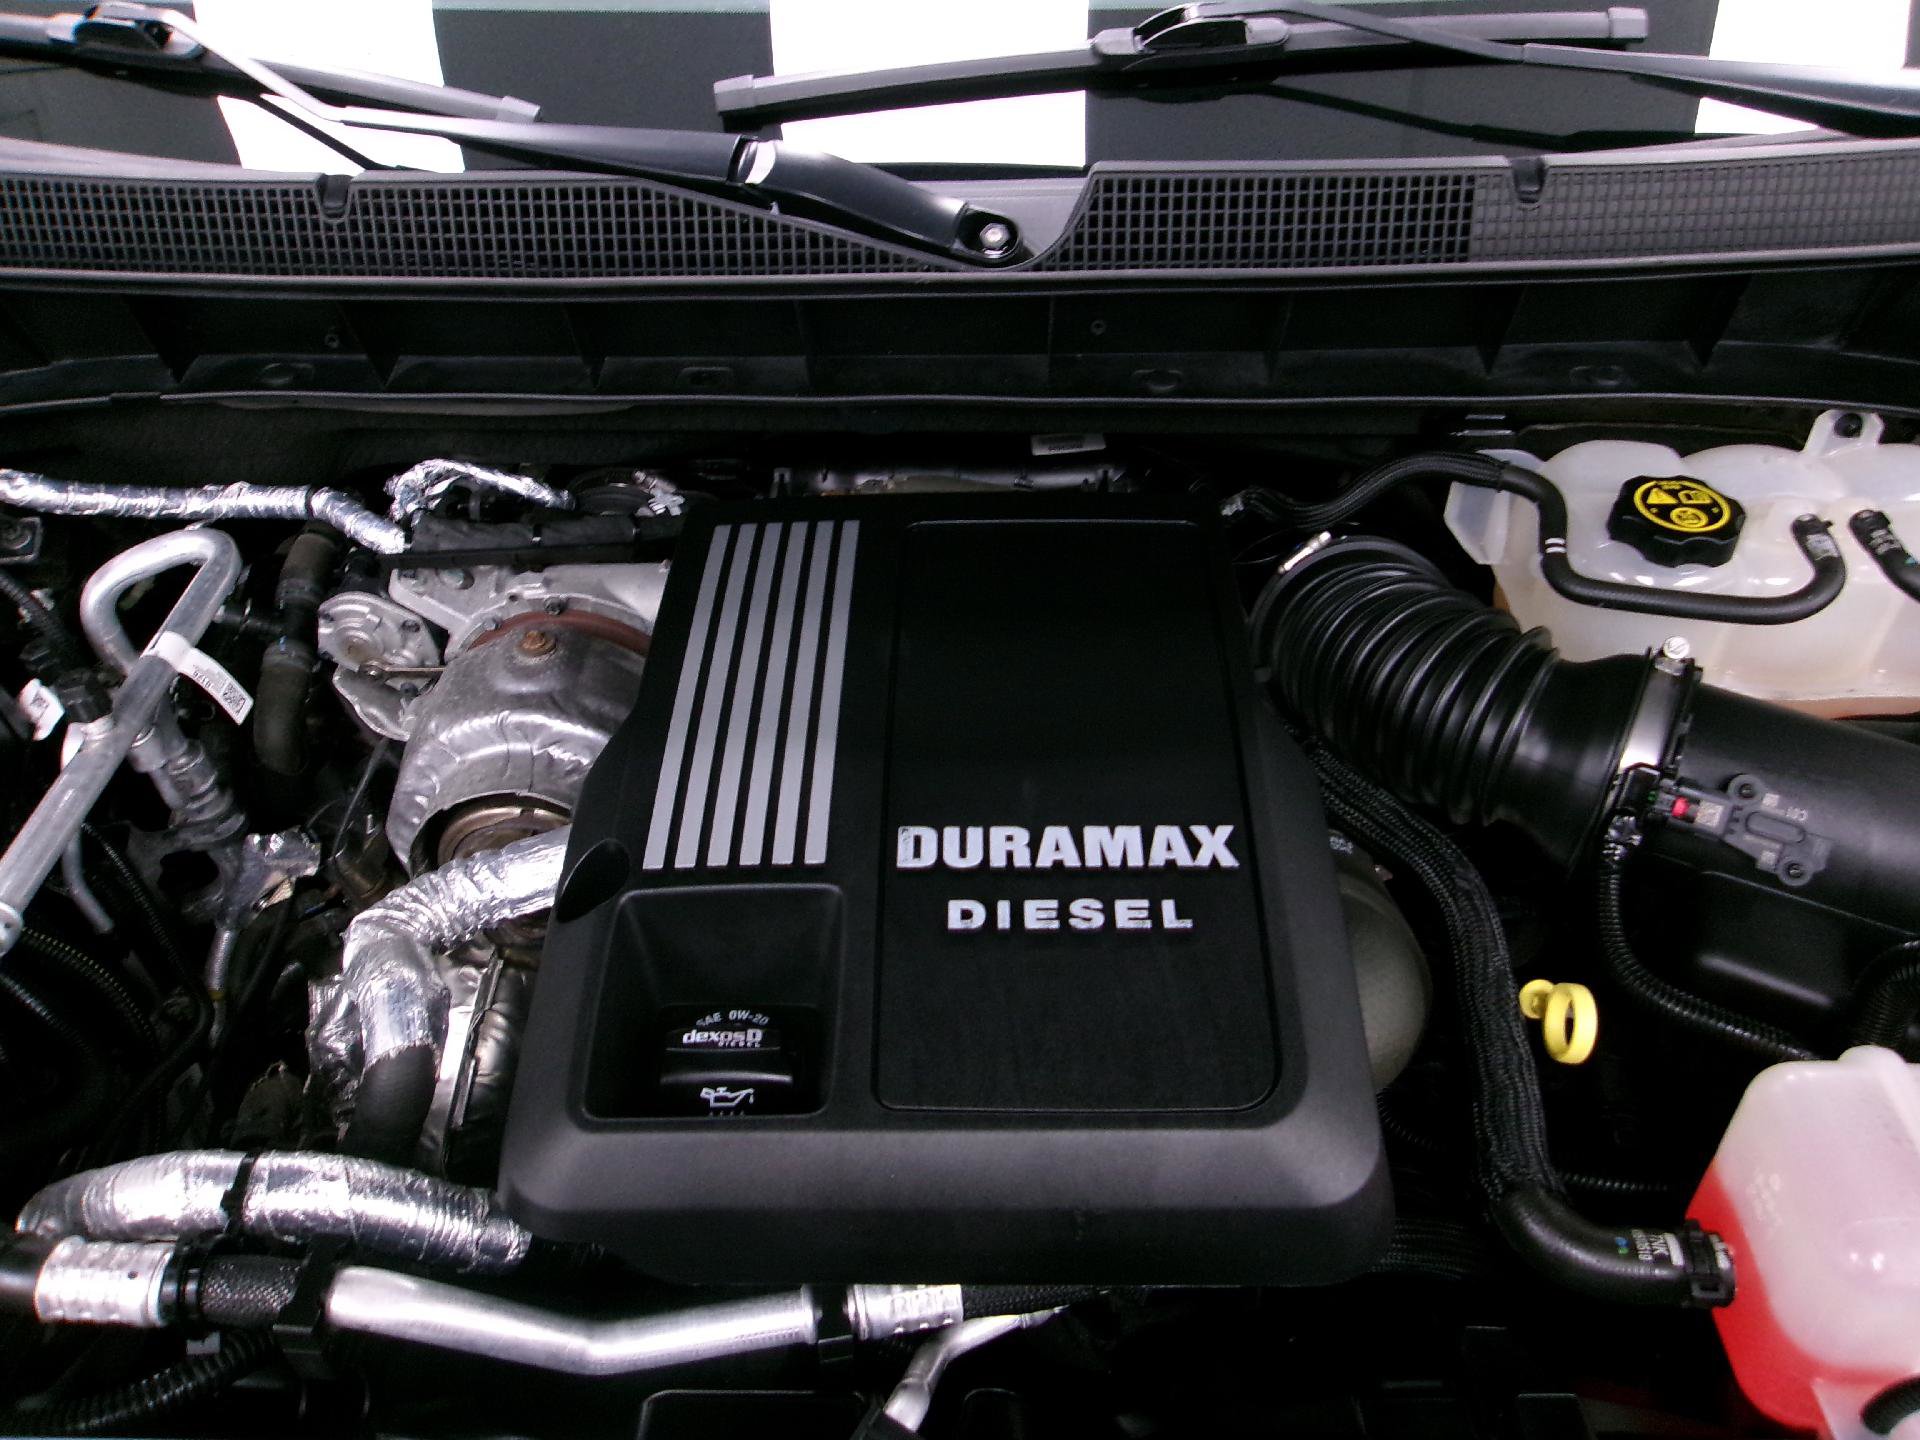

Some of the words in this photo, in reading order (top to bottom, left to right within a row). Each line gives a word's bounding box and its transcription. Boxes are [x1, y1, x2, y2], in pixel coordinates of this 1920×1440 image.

[896, 825, 1240, 868] DURAMAX
[947, 898, 1193, 929] DIESEL
[696, 1012, 722, 1026] SAE
[728, 1010, 770, 1025] 0W-20
